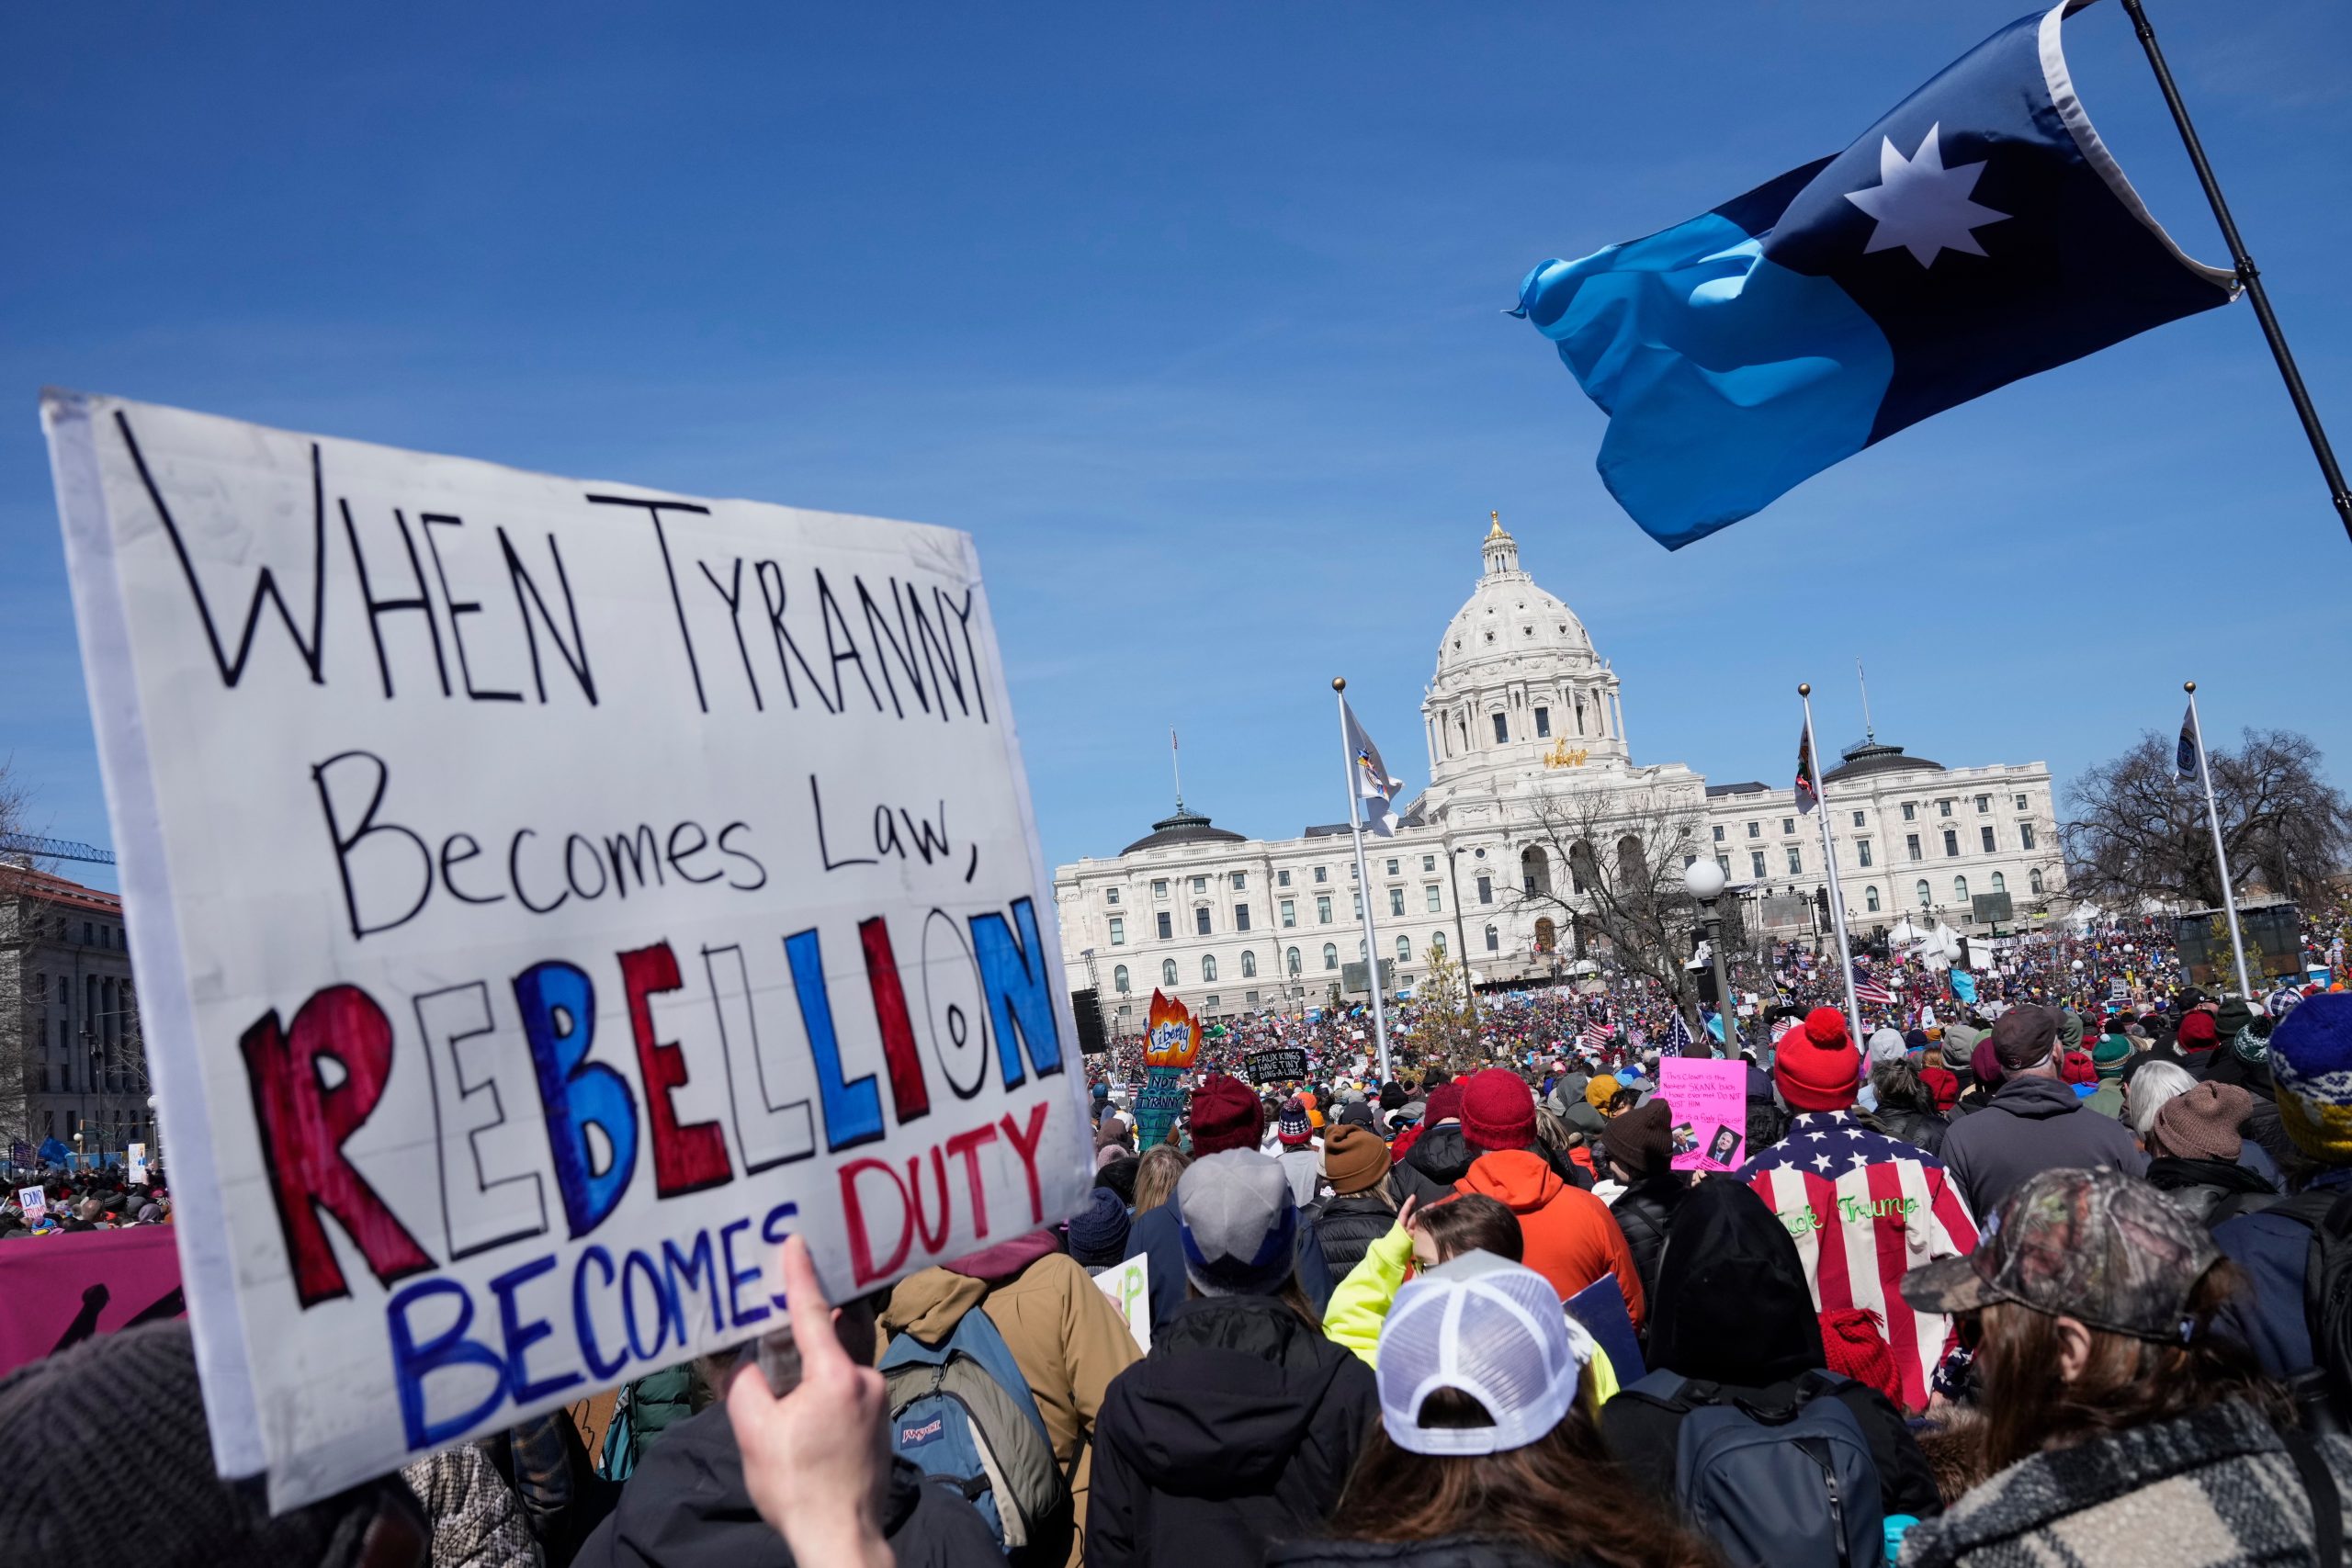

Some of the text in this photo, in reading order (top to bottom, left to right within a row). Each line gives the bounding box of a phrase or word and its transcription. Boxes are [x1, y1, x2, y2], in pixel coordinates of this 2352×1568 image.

[115, 409, 989, 725] WHEN TYRANNY
[310, 750, 978, 942] Becomes Law,
[1149, 1021, 1191, 1053] Liberty
[1256, 1052, 1301, 1064] FAUX KINGS
[1258, 1062, 1278, 1073] HAVE
[1278, 1060, 1299, 1069] TINY
[1260, 1068, 1304, 1079] DING-A-LINGS
[1665, 1072, 1680, 1080] This
[1152, 1076, 1178, 1087] NOT
[1690, 1083, 1716, 1091] SKANK
[1139, 1096, 1182, 1108] TYRANNY
[1729, 1092, 1742, 1100] NOT
[239, 895, 1066, 1312] REBELLION
[1668, 1100, 1685, 1108] RUST
[23, 1190, 42, 1207] DUMP
[24, 1206, 47, 1218] TRUMP
[1838, 1195, 1919, 1224] Trump
[387, 1100, 1049, 1453] BECOMES DUTY
